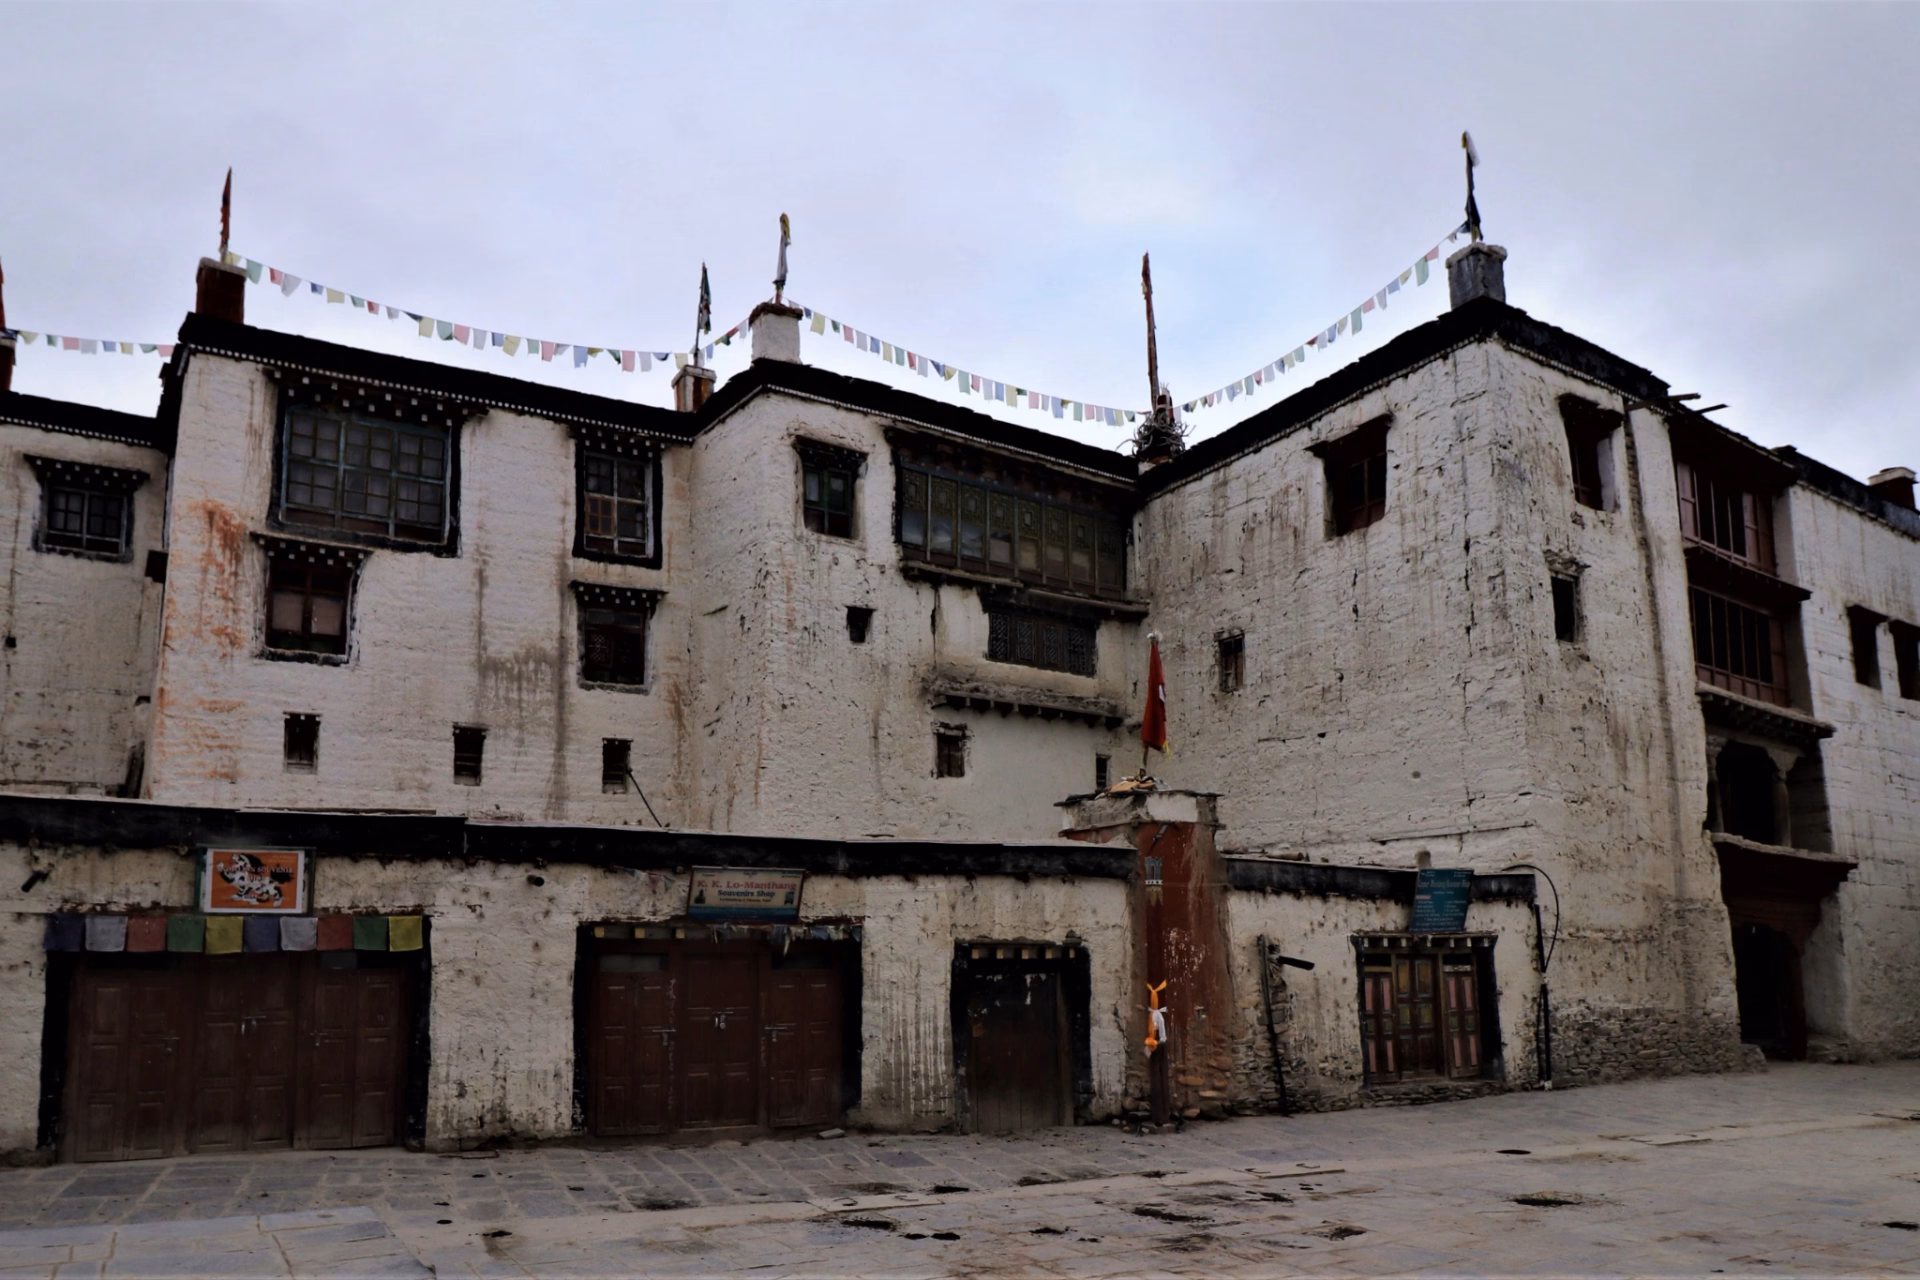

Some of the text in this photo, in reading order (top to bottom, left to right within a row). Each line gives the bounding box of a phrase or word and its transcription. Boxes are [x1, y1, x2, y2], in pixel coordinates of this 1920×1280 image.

[697, 880, 797, 891] K. K. Lo-Manthang
[717, 889, 776, 898] Souvenirs Shop
